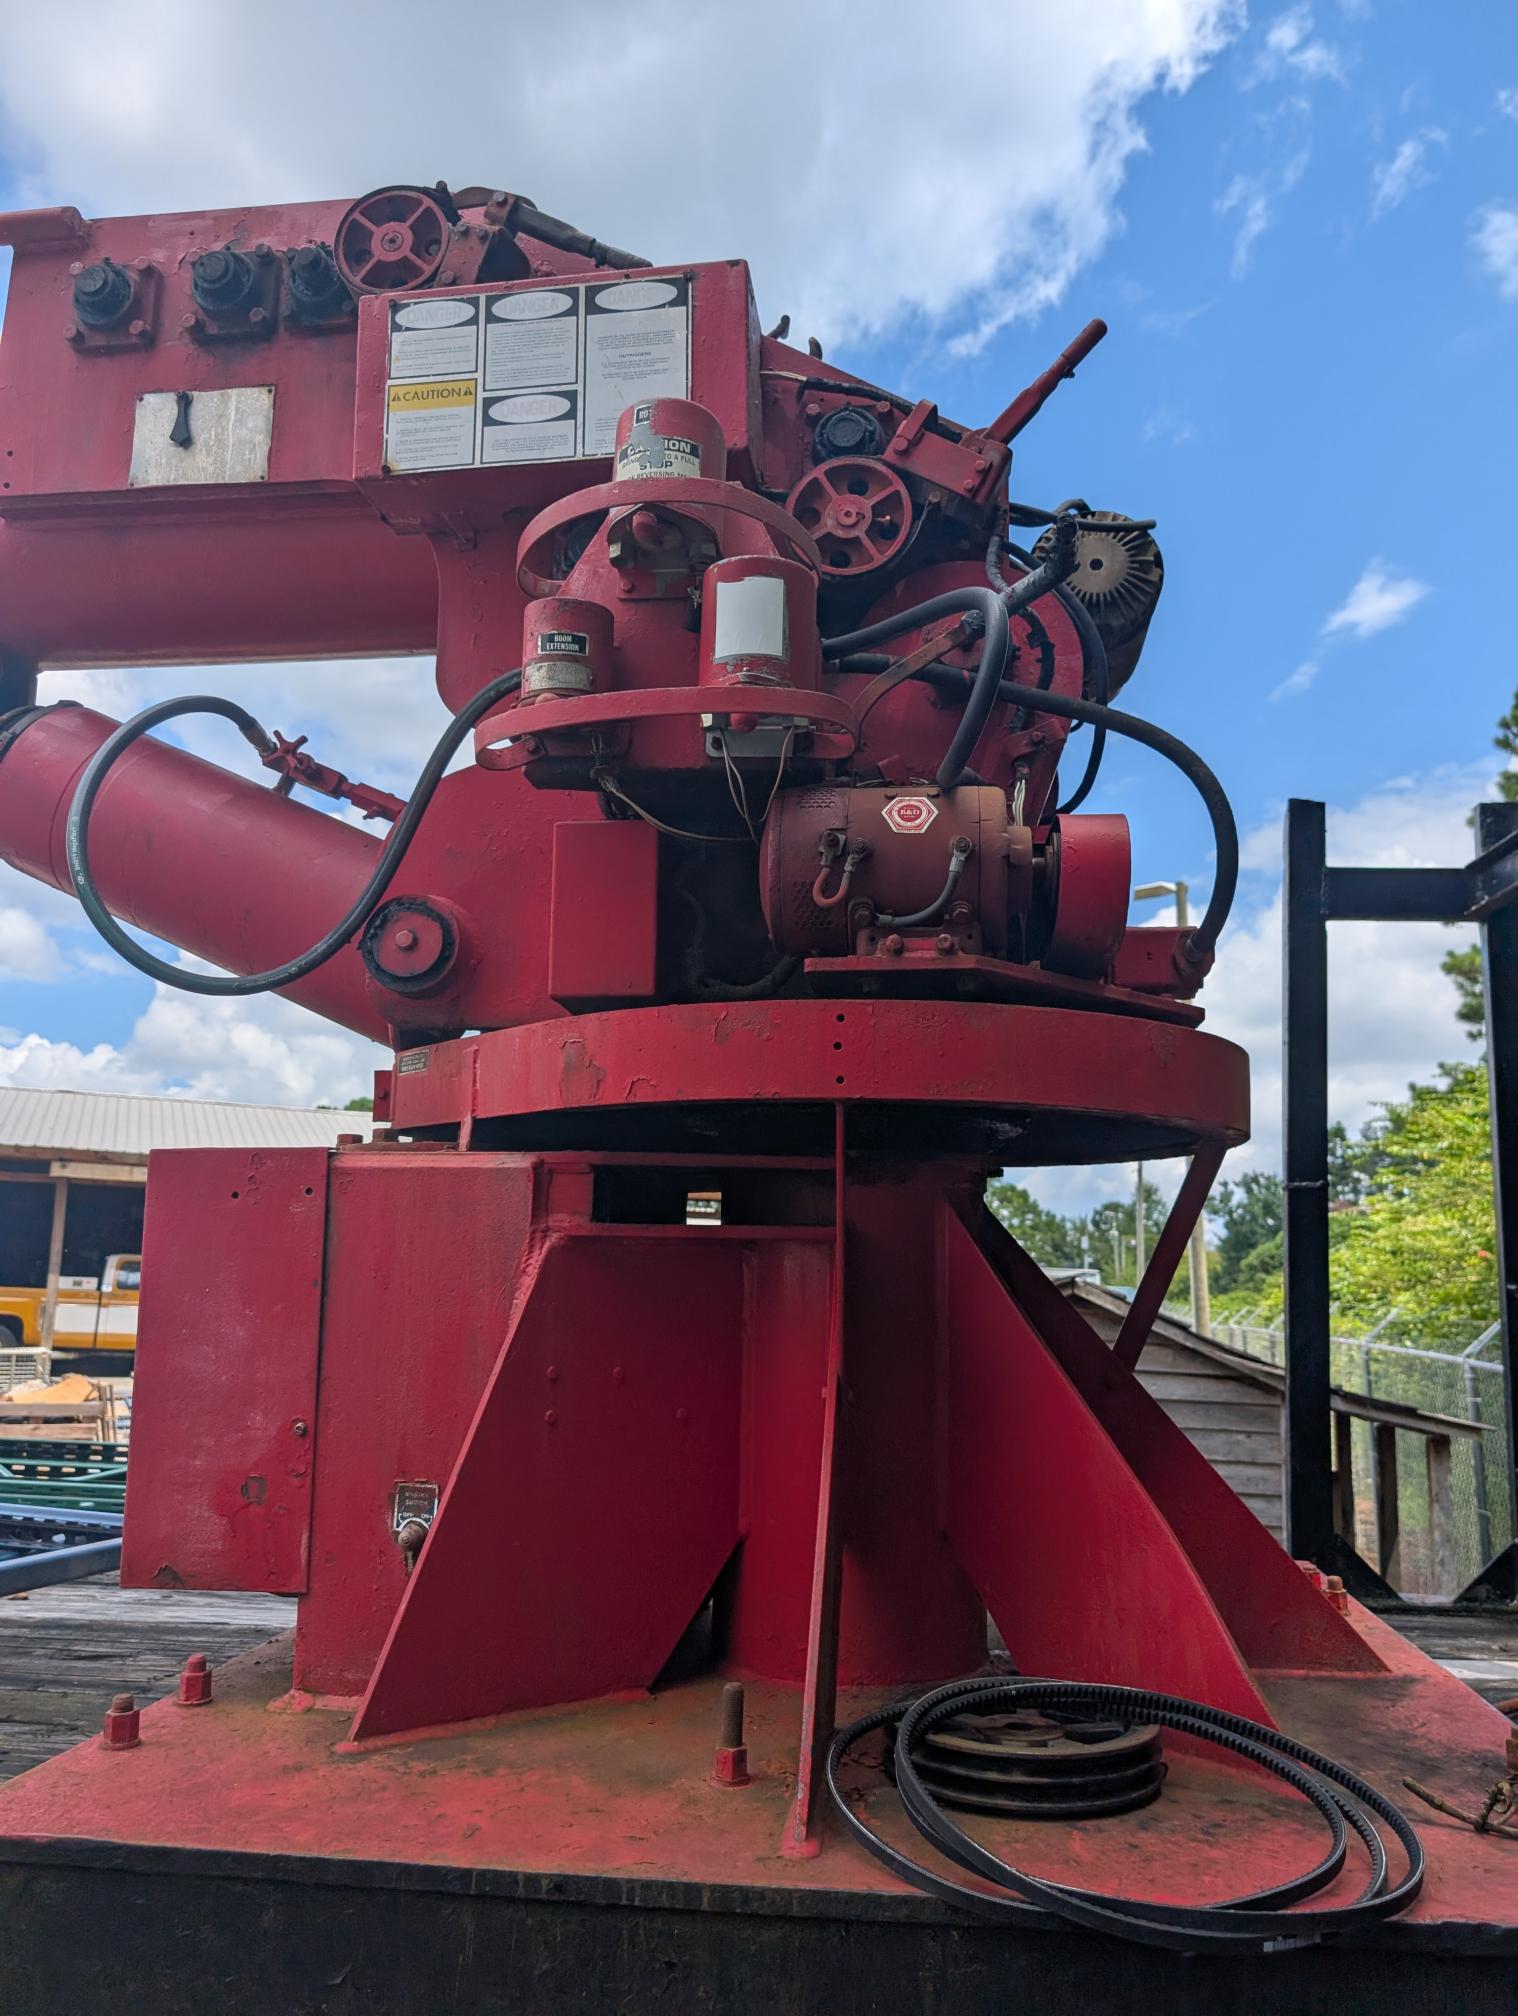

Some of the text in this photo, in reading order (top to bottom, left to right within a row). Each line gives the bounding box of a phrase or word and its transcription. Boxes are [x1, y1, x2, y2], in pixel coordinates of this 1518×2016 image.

[402, 388, 461, 401] CAUTION
[627, 438, 691, 456] CAION
[546, 643, 579, 651] EXTENSION
